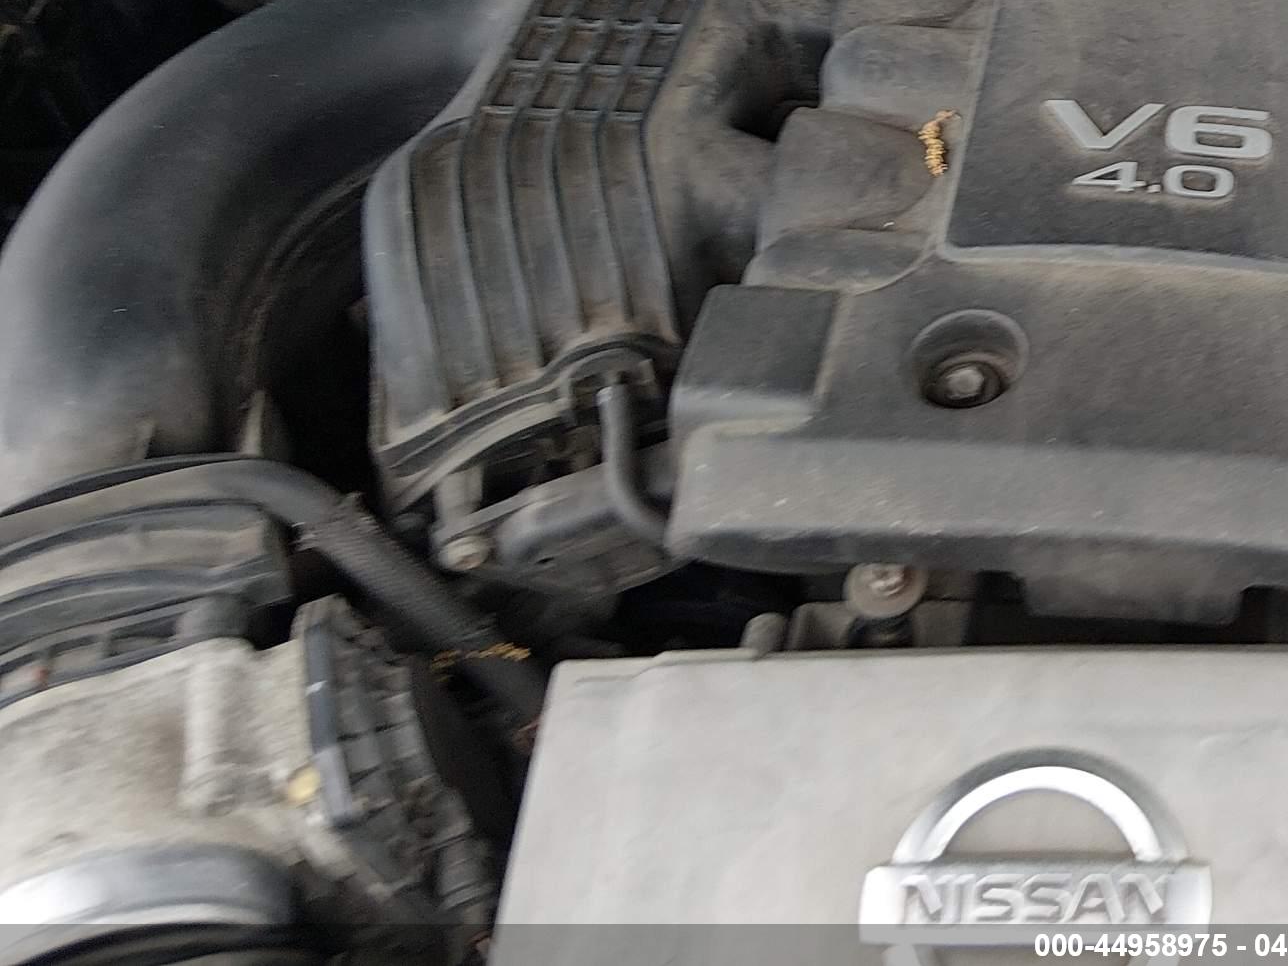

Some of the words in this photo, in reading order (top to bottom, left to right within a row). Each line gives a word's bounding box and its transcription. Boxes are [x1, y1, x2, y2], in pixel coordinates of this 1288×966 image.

[1044, 99, 1274, 160] V6
[1071, 161, 1236, 199] 4.0
[900, 872, 1172, 925] NISSAN
